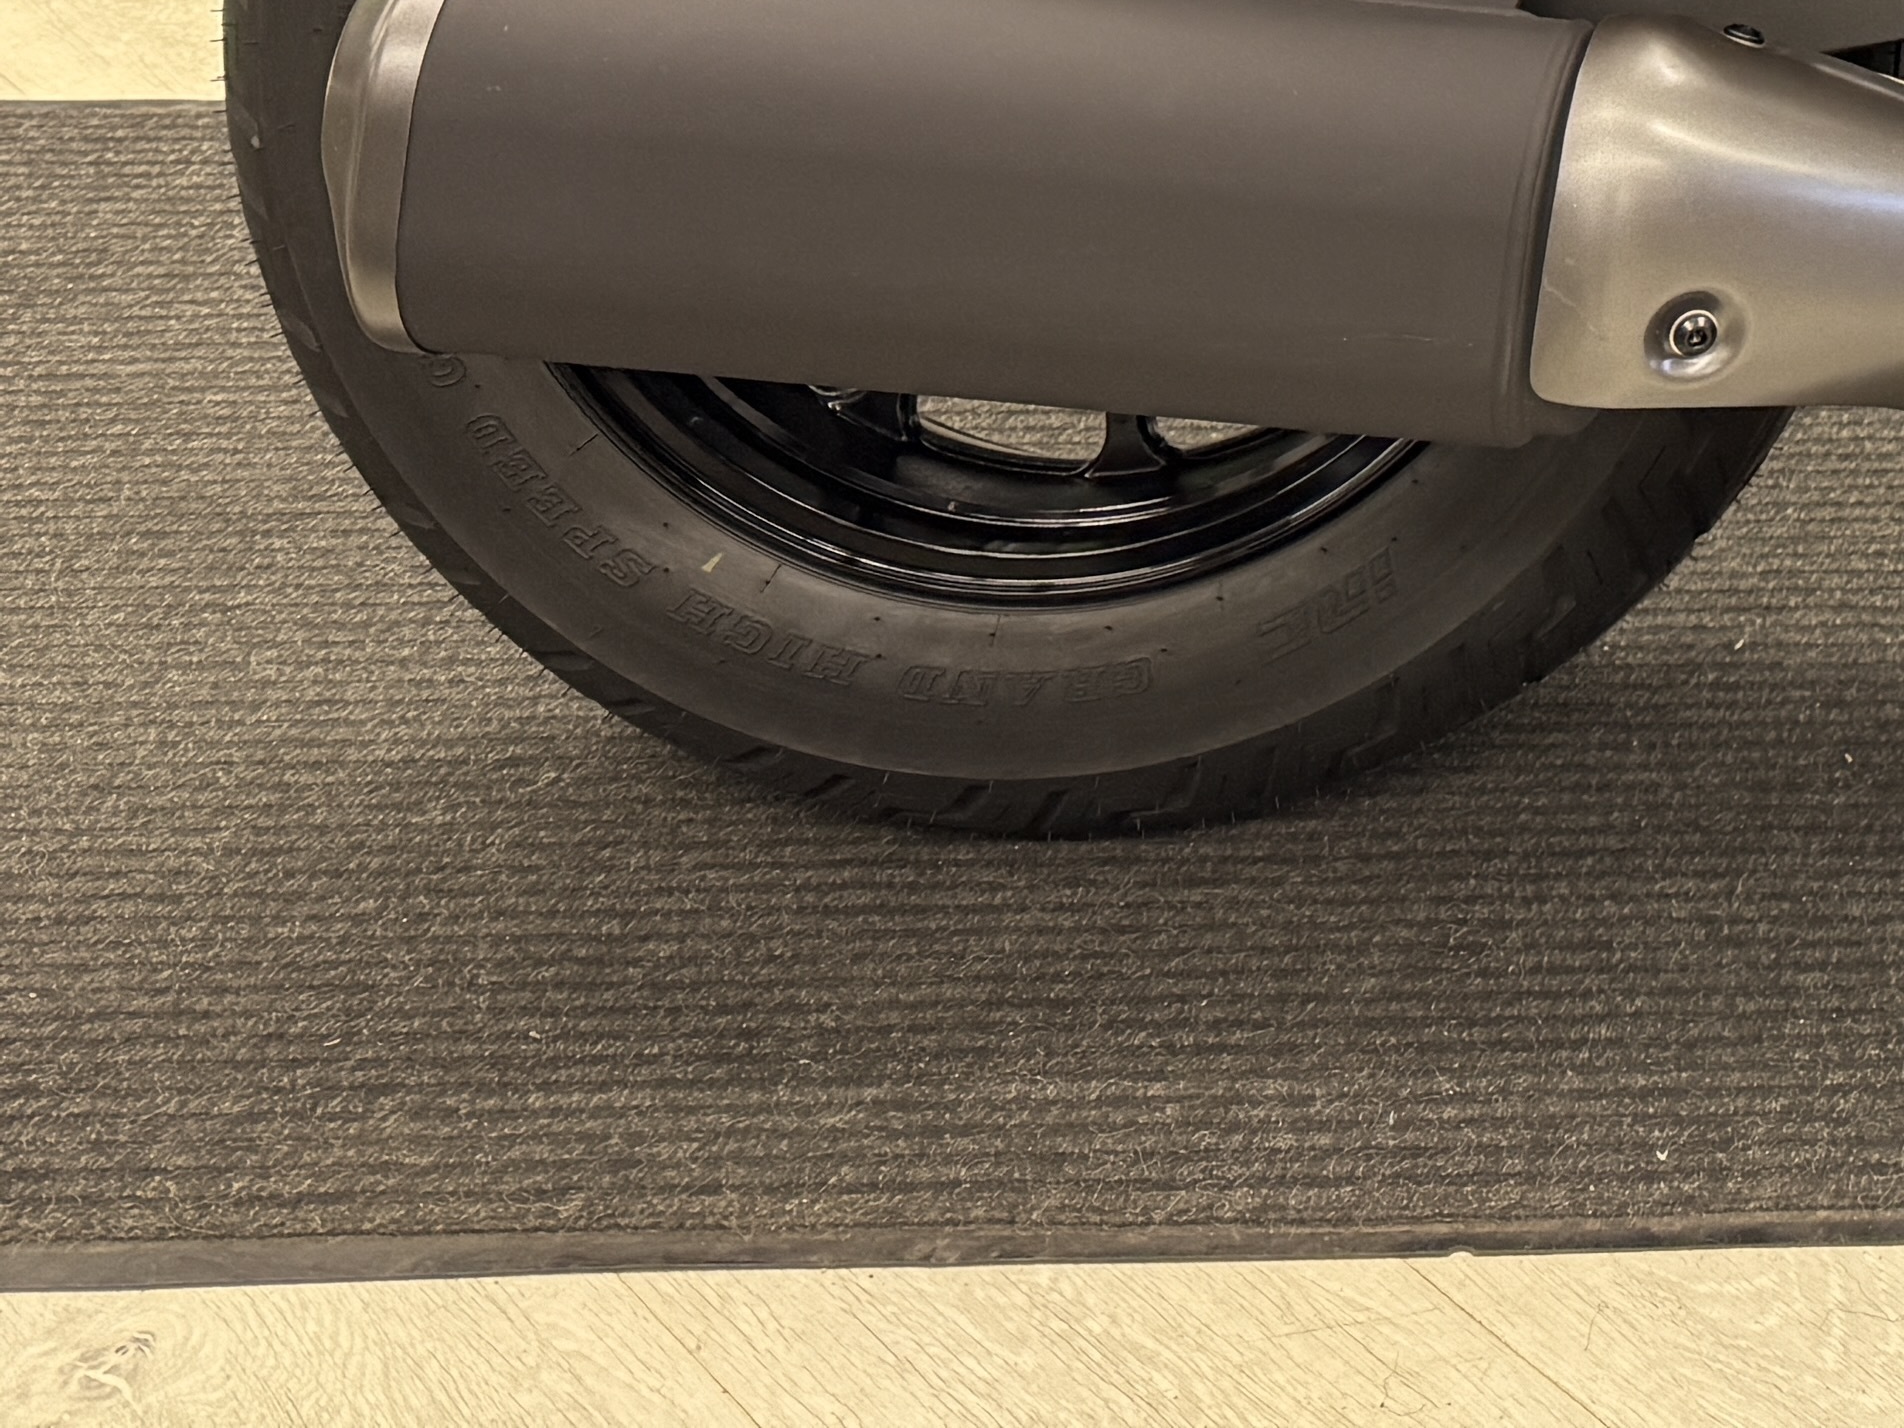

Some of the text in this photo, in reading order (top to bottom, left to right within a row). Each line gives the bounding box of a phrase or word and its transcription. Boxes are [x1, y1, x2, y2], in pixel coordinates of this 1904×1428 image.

[459, 403, 660, 599] SPEED
[663, 579, 872, 694] HIGH
[895, 656, 1158, 708] GRAND
